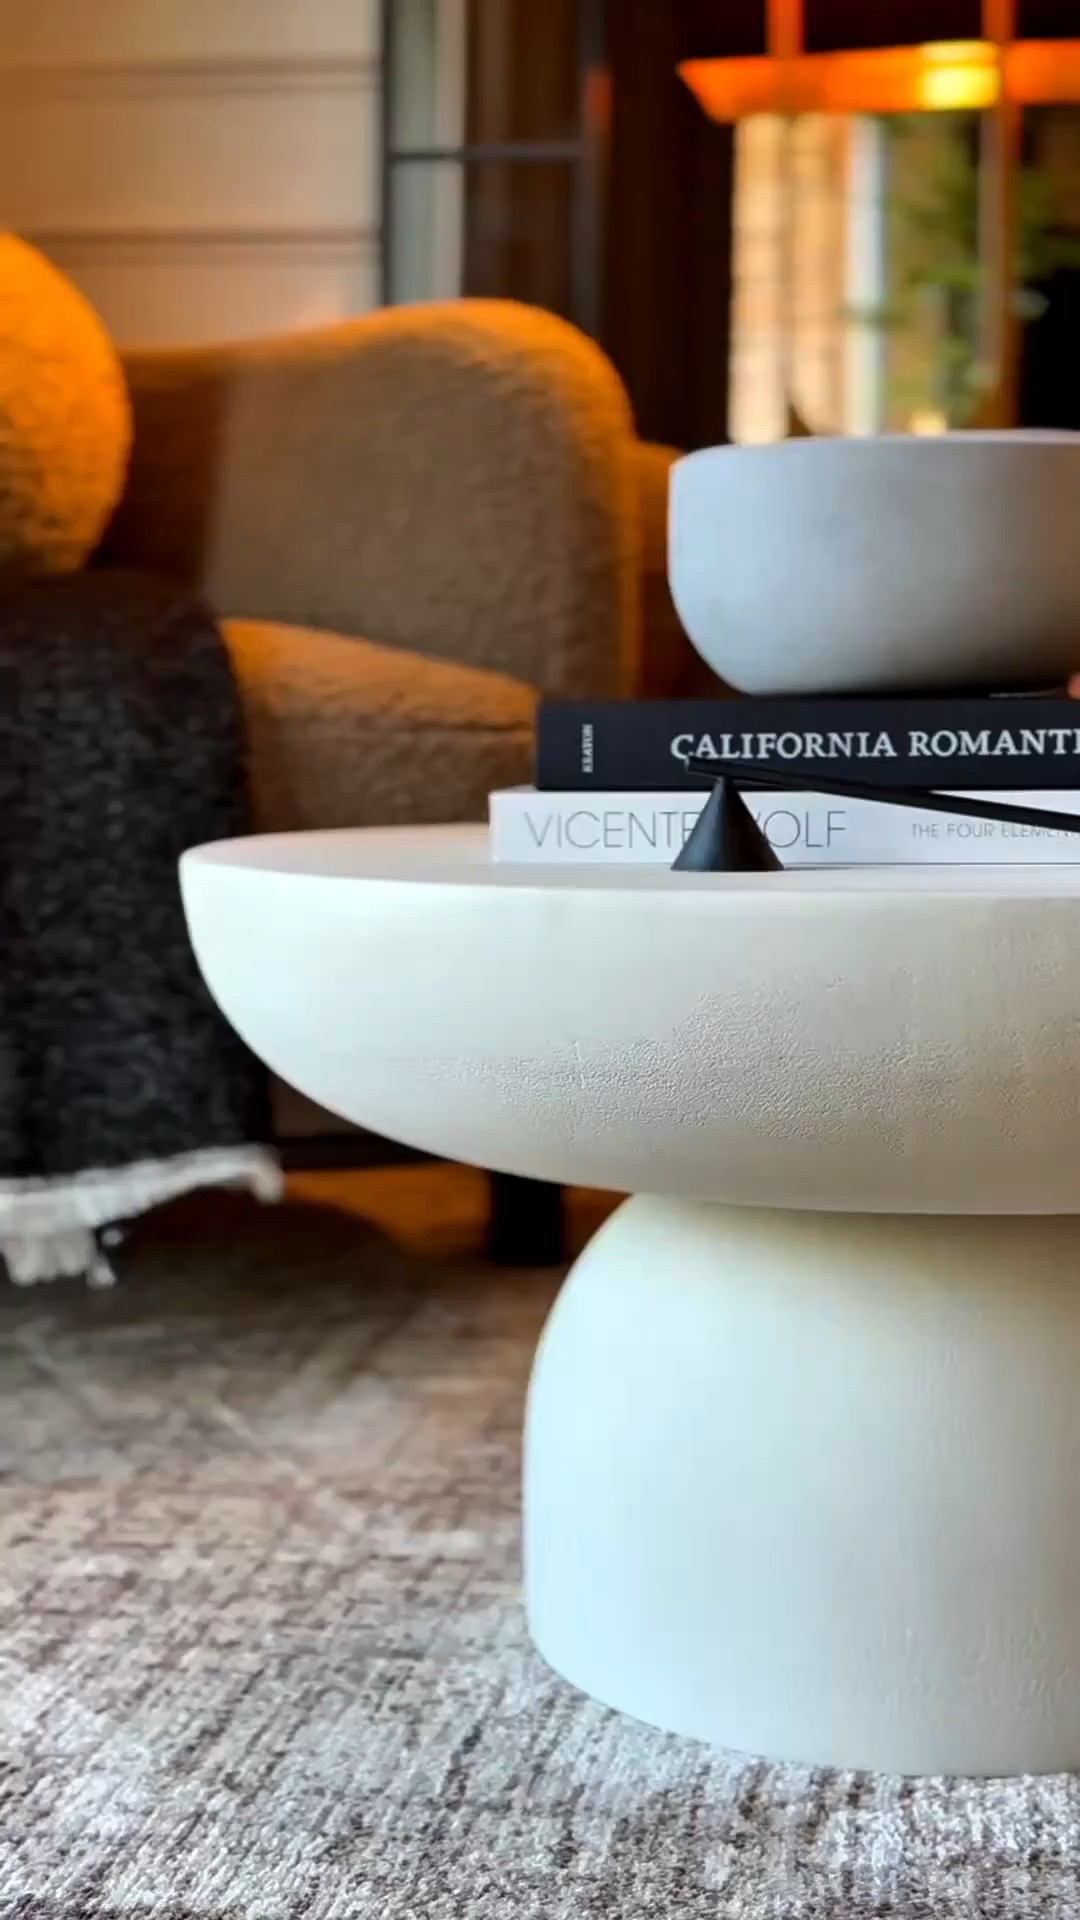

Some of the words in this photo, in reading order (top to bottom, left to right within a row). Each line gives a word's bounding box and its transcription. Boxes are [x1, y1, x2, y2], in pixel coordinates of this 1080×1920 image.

[670, 731, 897, 760] CALIFORNIA
[755, 810, 848, 849] OLF
[912, 823, 940, 838] THE
[947, 823, 995, 838] FOUR
